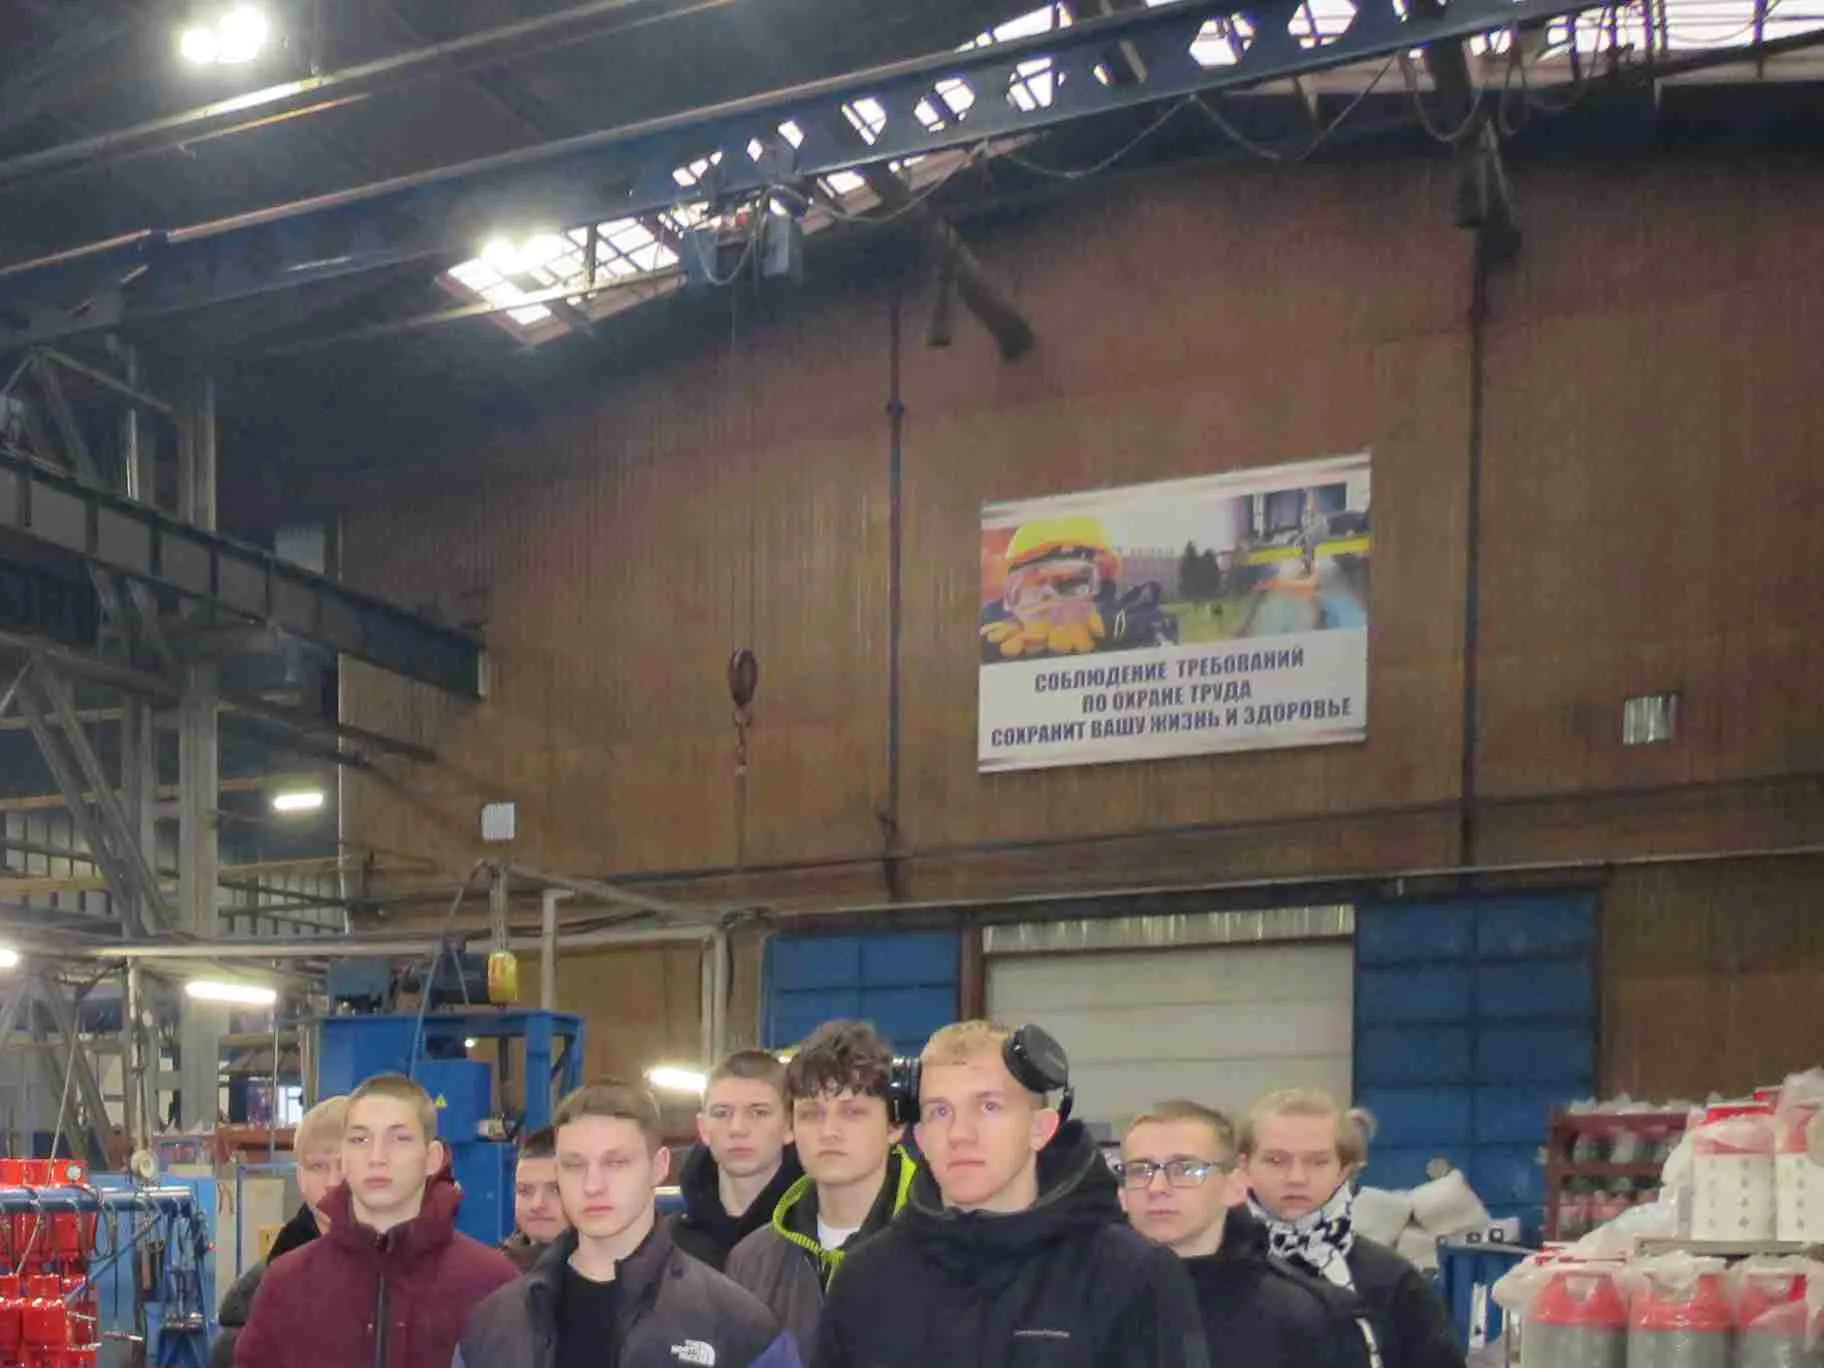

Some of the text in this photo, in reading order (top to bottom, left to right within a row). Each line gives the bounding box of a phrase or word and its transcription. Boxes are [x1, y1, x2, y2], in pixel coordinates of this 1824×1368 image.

[1034, 645, 1304, 693] СОБЛЮДЕНИЕ ТРЕБОВАНИЙ
[1081, 680, 1251, 714] ПО ОХРАНЕ ТРУДА
[990, 697, 1352, 747] СОХРАНИТ ВАШУ ЖИЗНЬ И ЗДОРОВЬЕ
